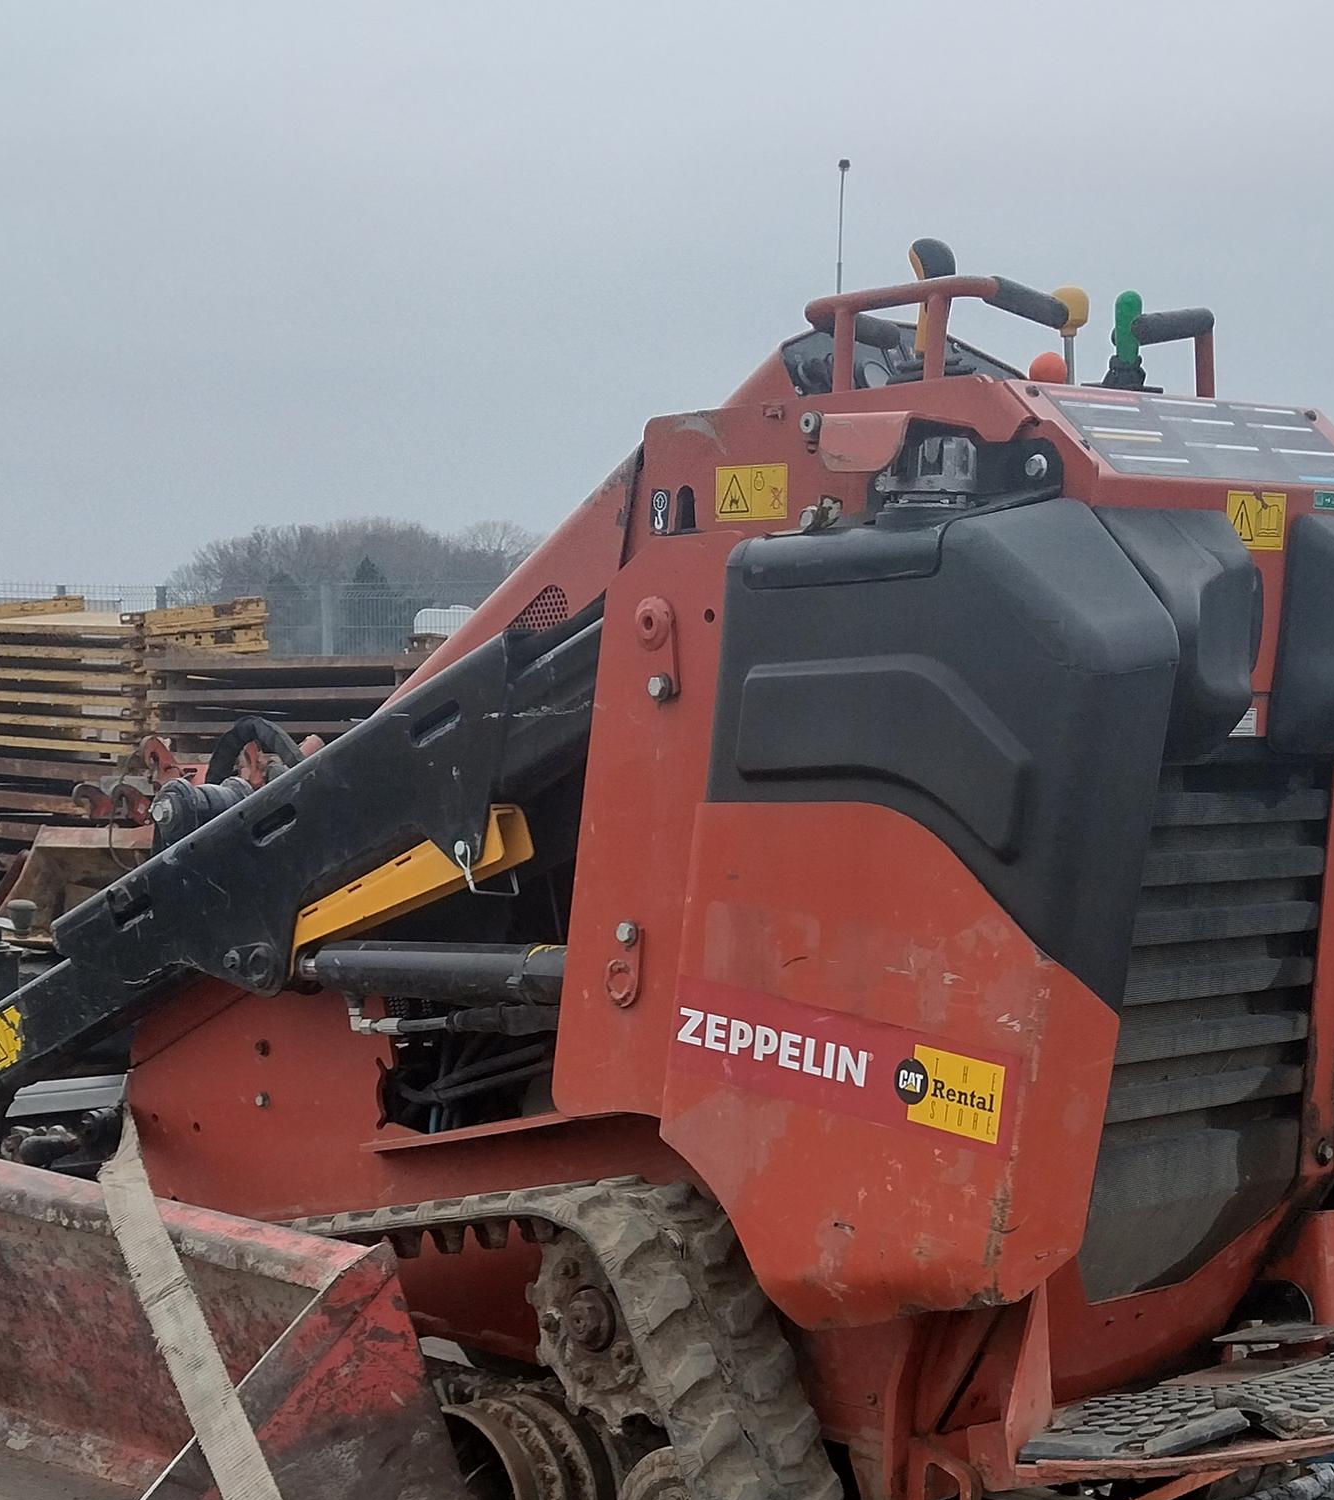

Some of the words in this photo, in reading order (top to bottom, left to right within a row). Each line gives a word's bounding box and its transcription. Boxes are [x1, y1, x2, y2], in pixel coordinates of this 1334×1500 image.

[677, 1007, 867, 1088] ZEPPELIN
[899, 1069, 923, 1093] CAT
[931, 1078, 994, 1112] Rental
[930, 1101, 993, 1135] STORE
